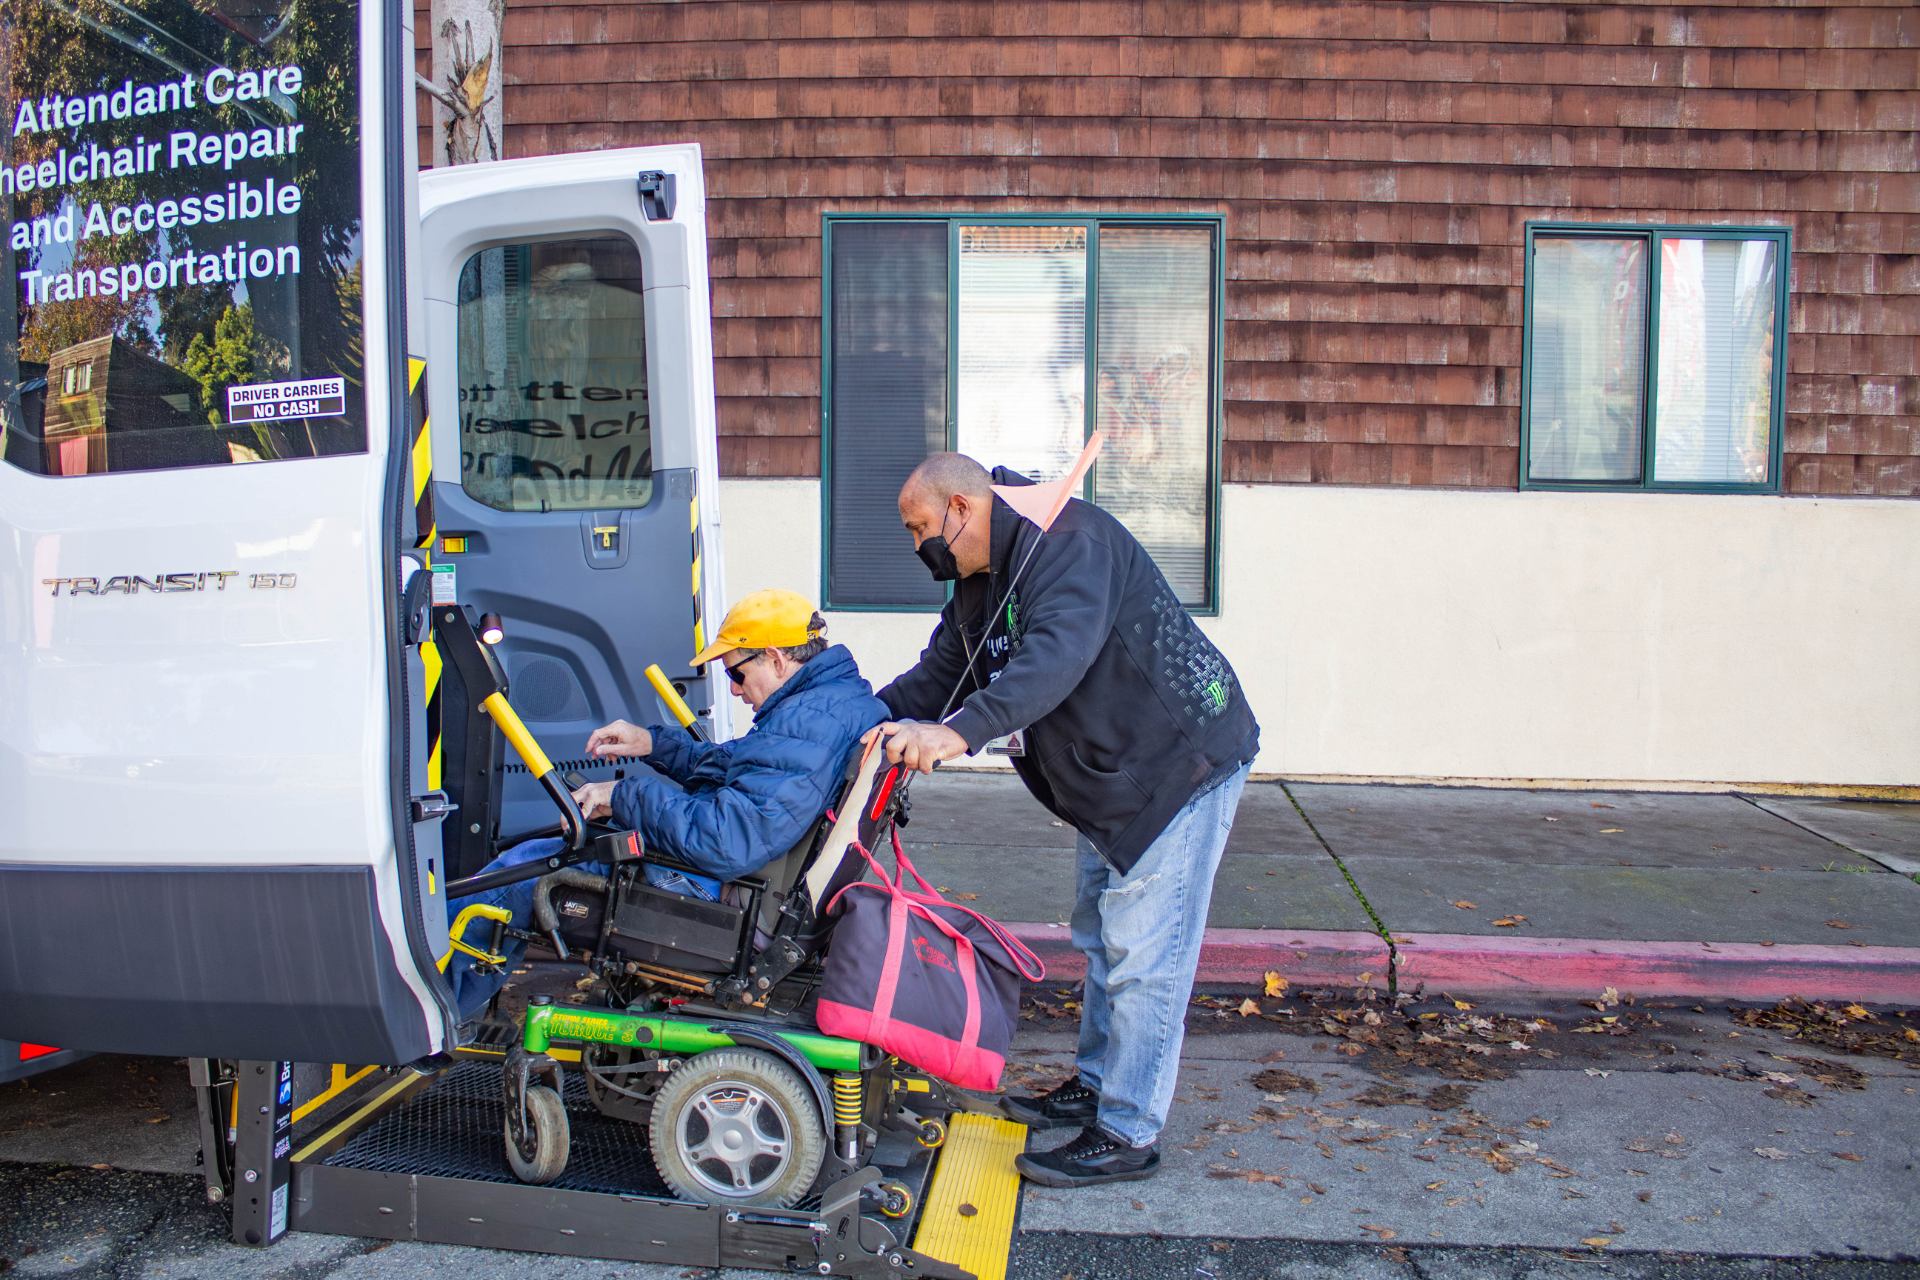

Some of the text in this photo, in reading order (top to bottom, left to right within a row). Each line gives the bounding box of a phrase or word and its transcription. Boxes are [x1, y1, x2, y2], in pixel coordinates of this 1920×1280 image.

[13, 66, 302, 137] Attendant Care
[170, 124, 304, 170] Repair
[11, 178, 301, 251] and Accessible
[20, 241, 300, 306] Transportation
[233, 383, 339, 402] DRIVER CARRIES
[254, 400, 319, 418] NO CASH
[42, 571, 296, 597] TRANSIT 150
[550, 1020, 616, 1041] TORQUE
